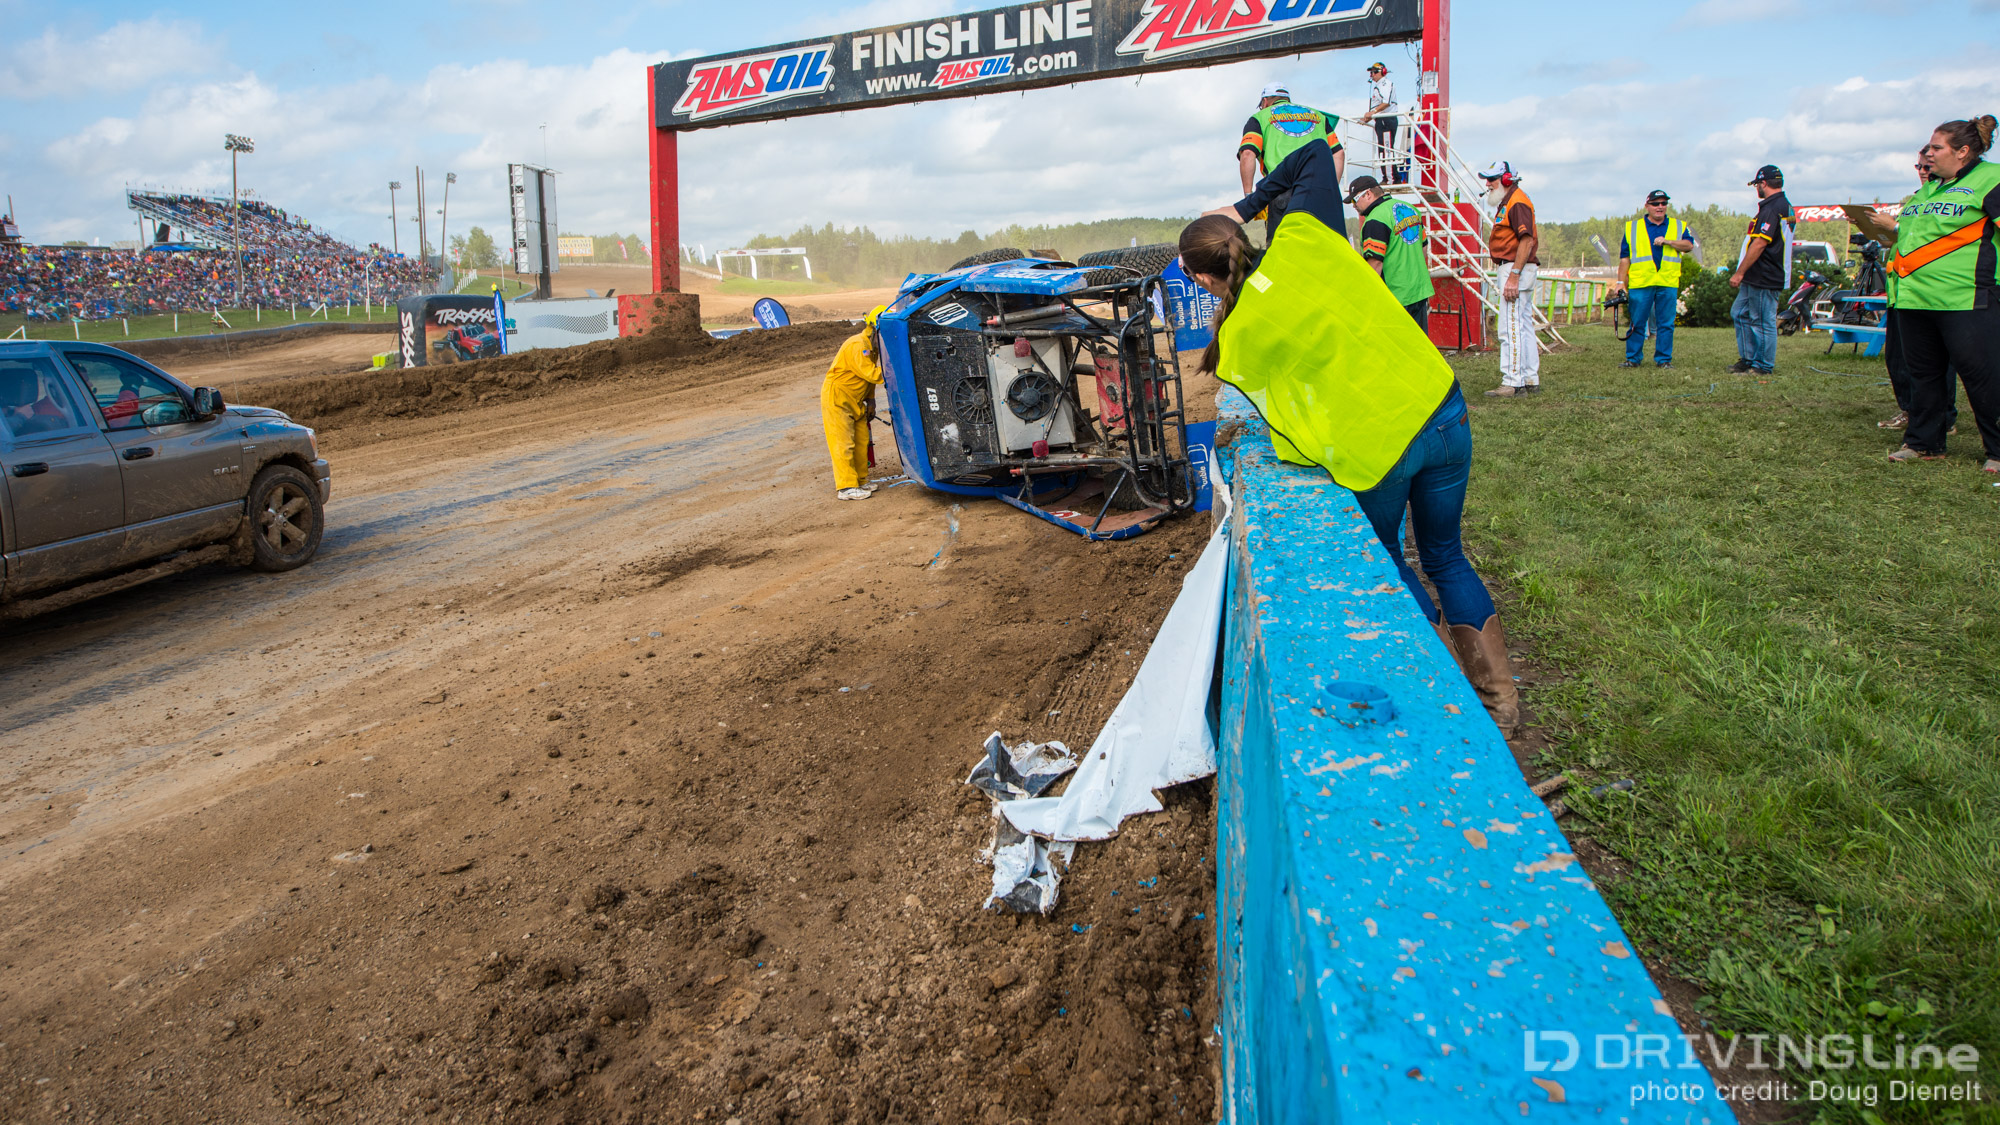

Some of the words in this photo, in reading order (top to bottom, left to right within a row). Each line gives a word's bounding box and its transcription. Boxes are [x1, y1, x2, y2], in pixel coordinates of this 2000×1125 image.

[852, 17, 979, 71] FINISH
[994, 0, 1092, 50] LINE
[678, 46, 832, 117] AMSOIL
[865, 72, 927, 95] www.
[1924, 202, 1968, 218] CREW
[1187, 284, 1195, 297] Inc.
[1176, 301, 1186, 326] Double
[1189, 298, 1198, 330] Services,
[926, 387, 940, 411] 887
